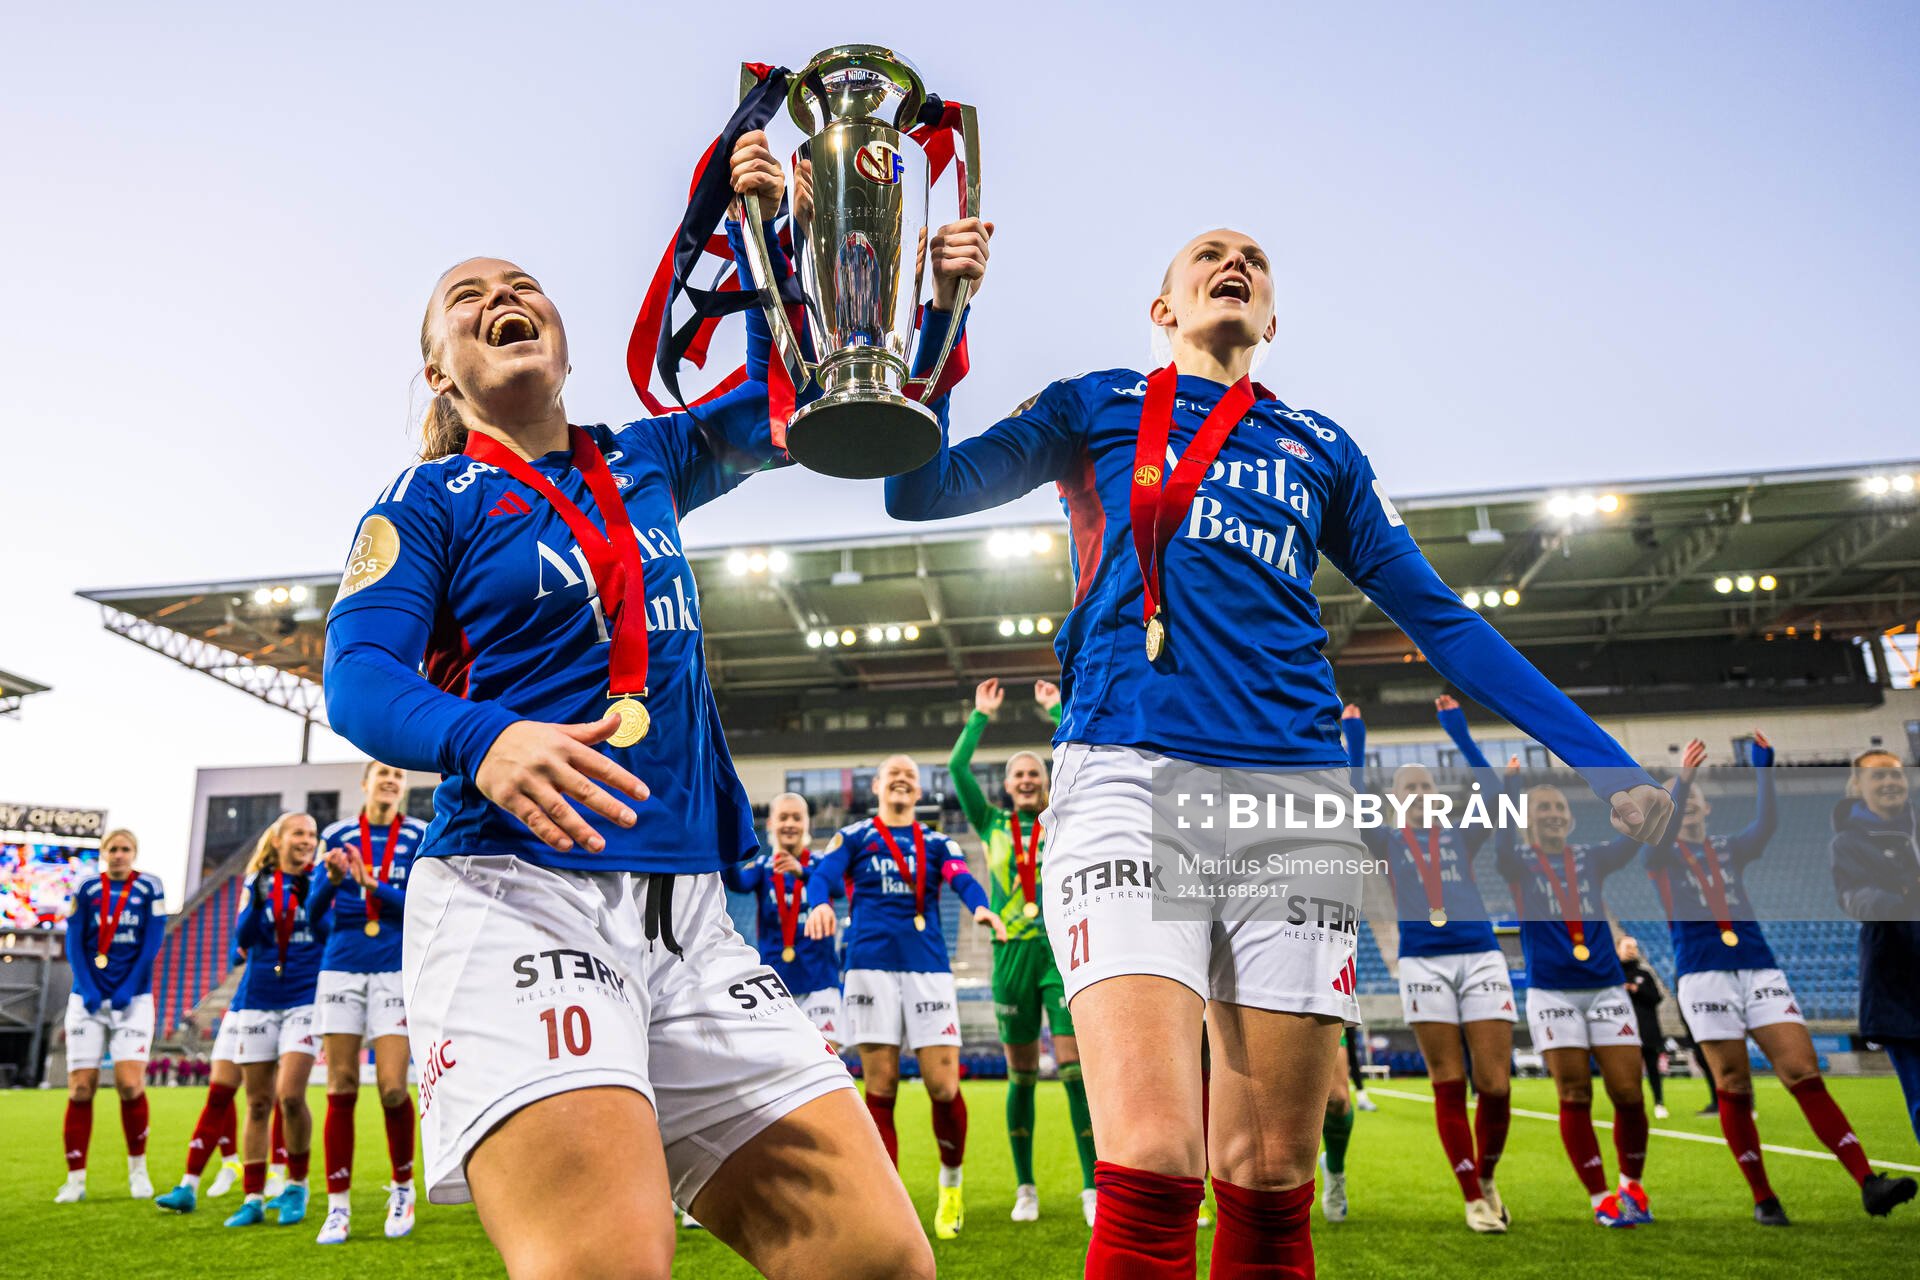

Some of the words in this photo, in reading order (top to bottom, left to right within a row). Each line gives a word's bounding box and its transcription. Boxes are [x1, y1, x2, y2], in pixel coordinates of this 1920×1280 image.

[1184, 496, 1299, 580] Bank
[1109, 890, 1169, 904] TRENING
[1068, 917, 1090, 972] 21
[1284, 930, 1325, 942] HELSE
[540, 1005, 593, 1060] 10
